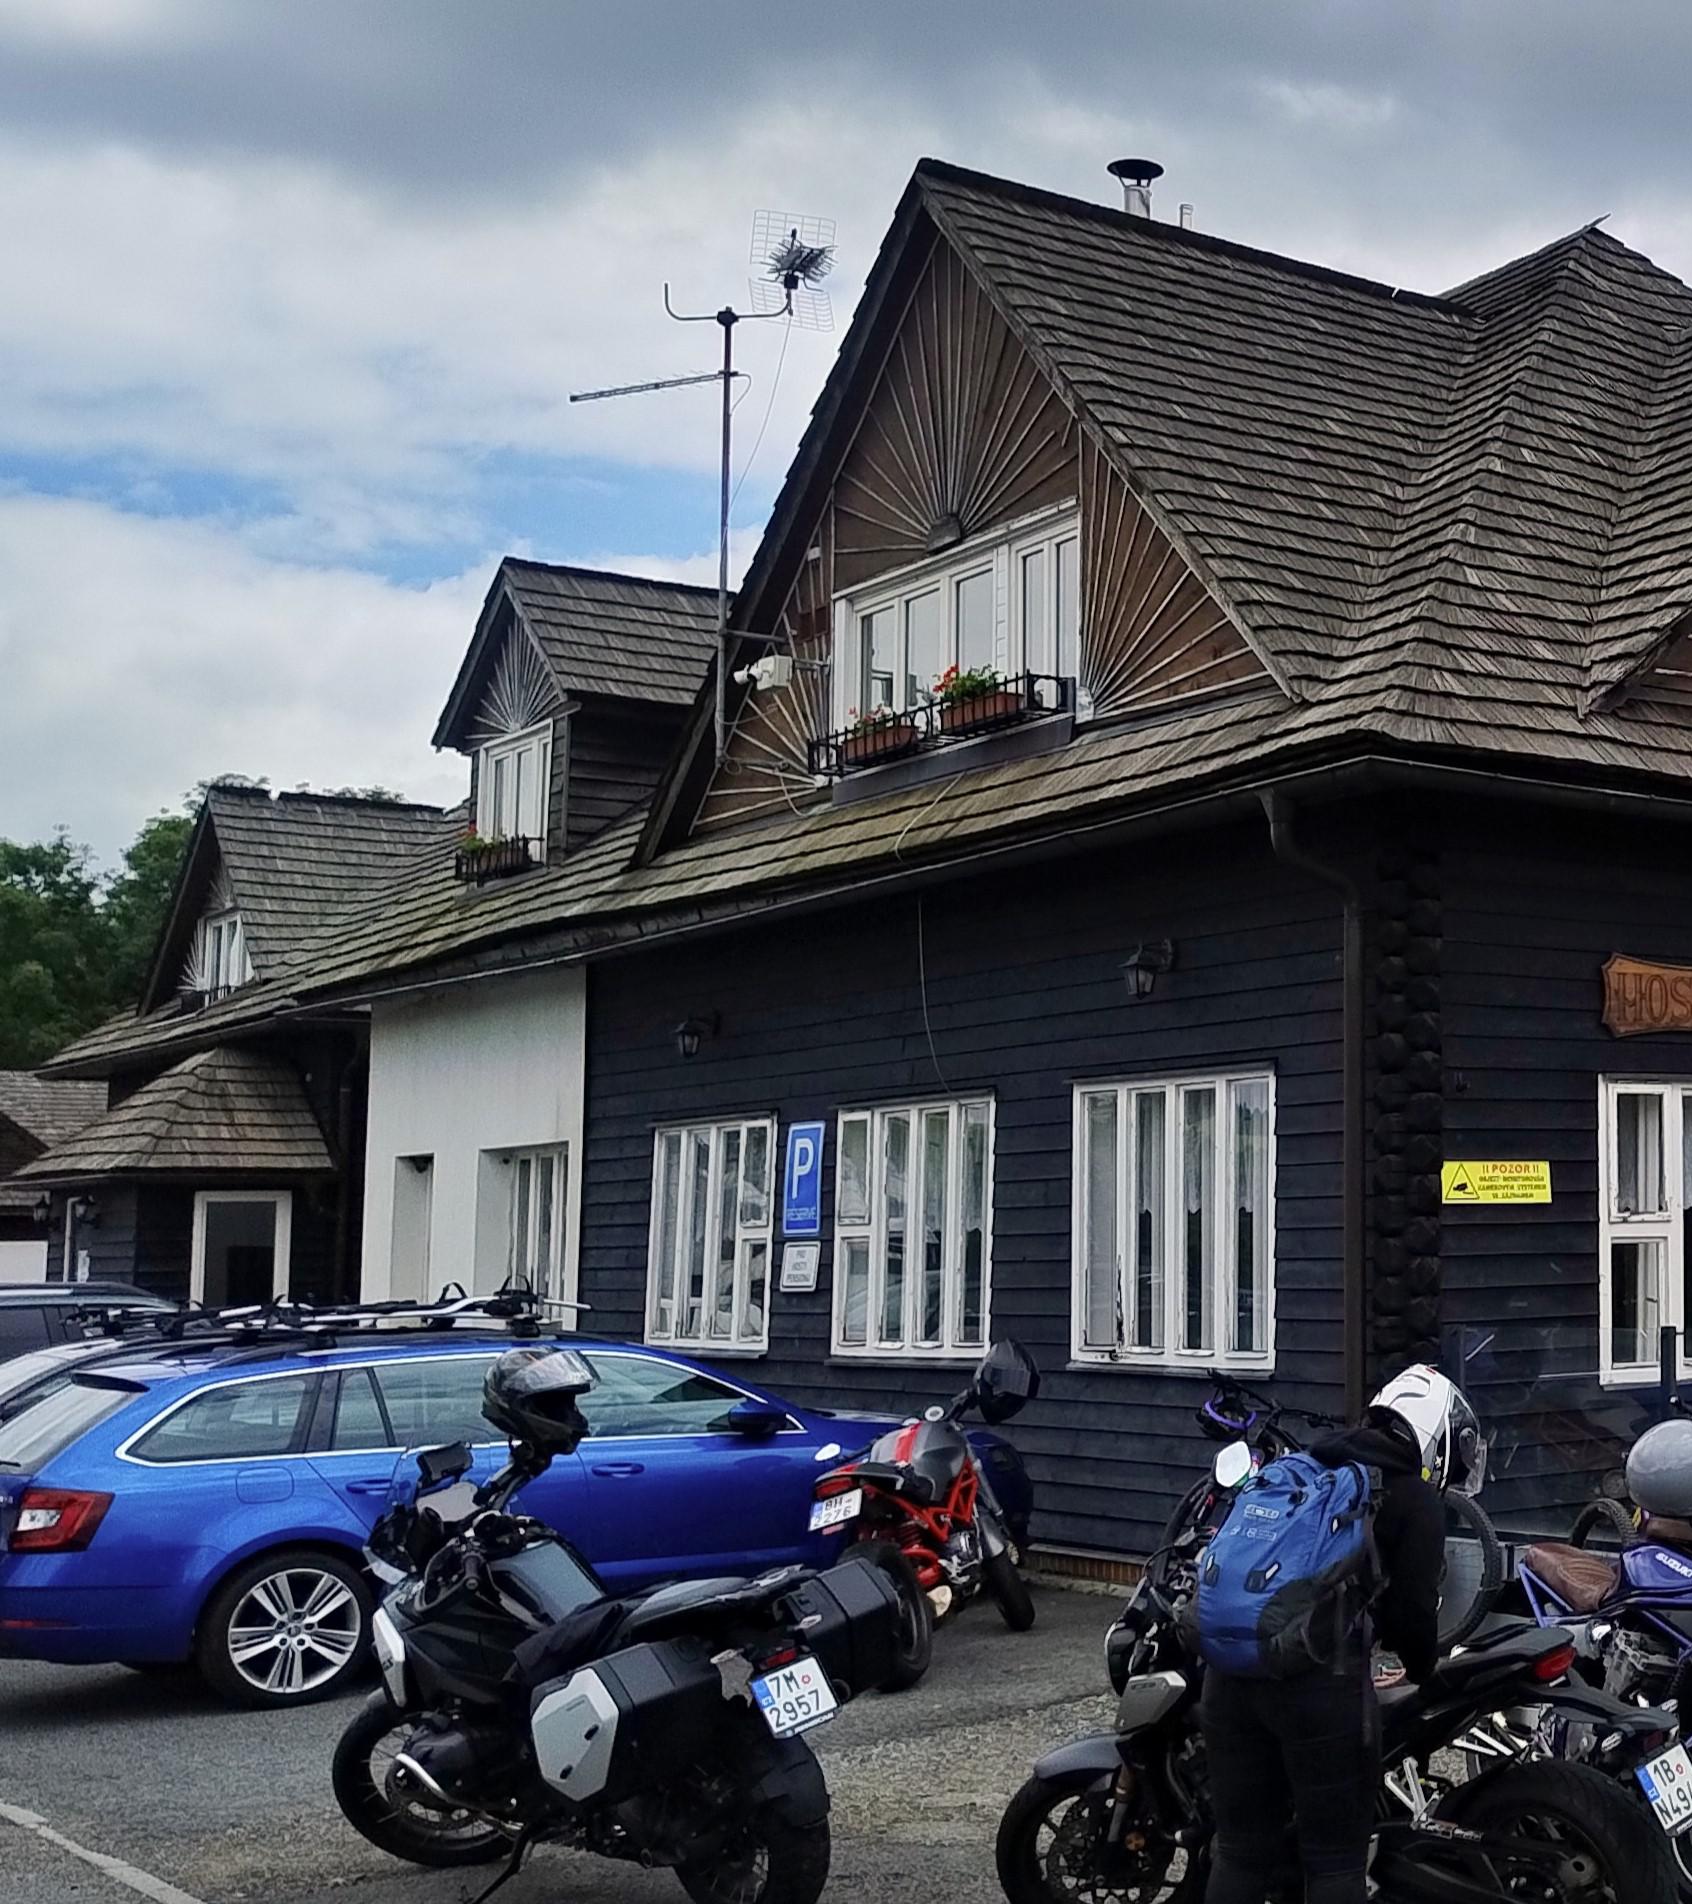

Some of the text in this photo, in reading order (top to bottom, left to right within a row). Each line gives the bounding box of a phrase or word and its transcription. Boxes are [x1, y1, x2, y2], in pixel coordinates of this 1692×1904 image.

[792, 1137, 813, 1200] P
[1492, 1164, 1530, 1174] POZOR
[769, 1671, 800, 1698] 7M
[769, 1689, 821, 1728] 2957
[1653, 1759, 1675, 1787] 1B
